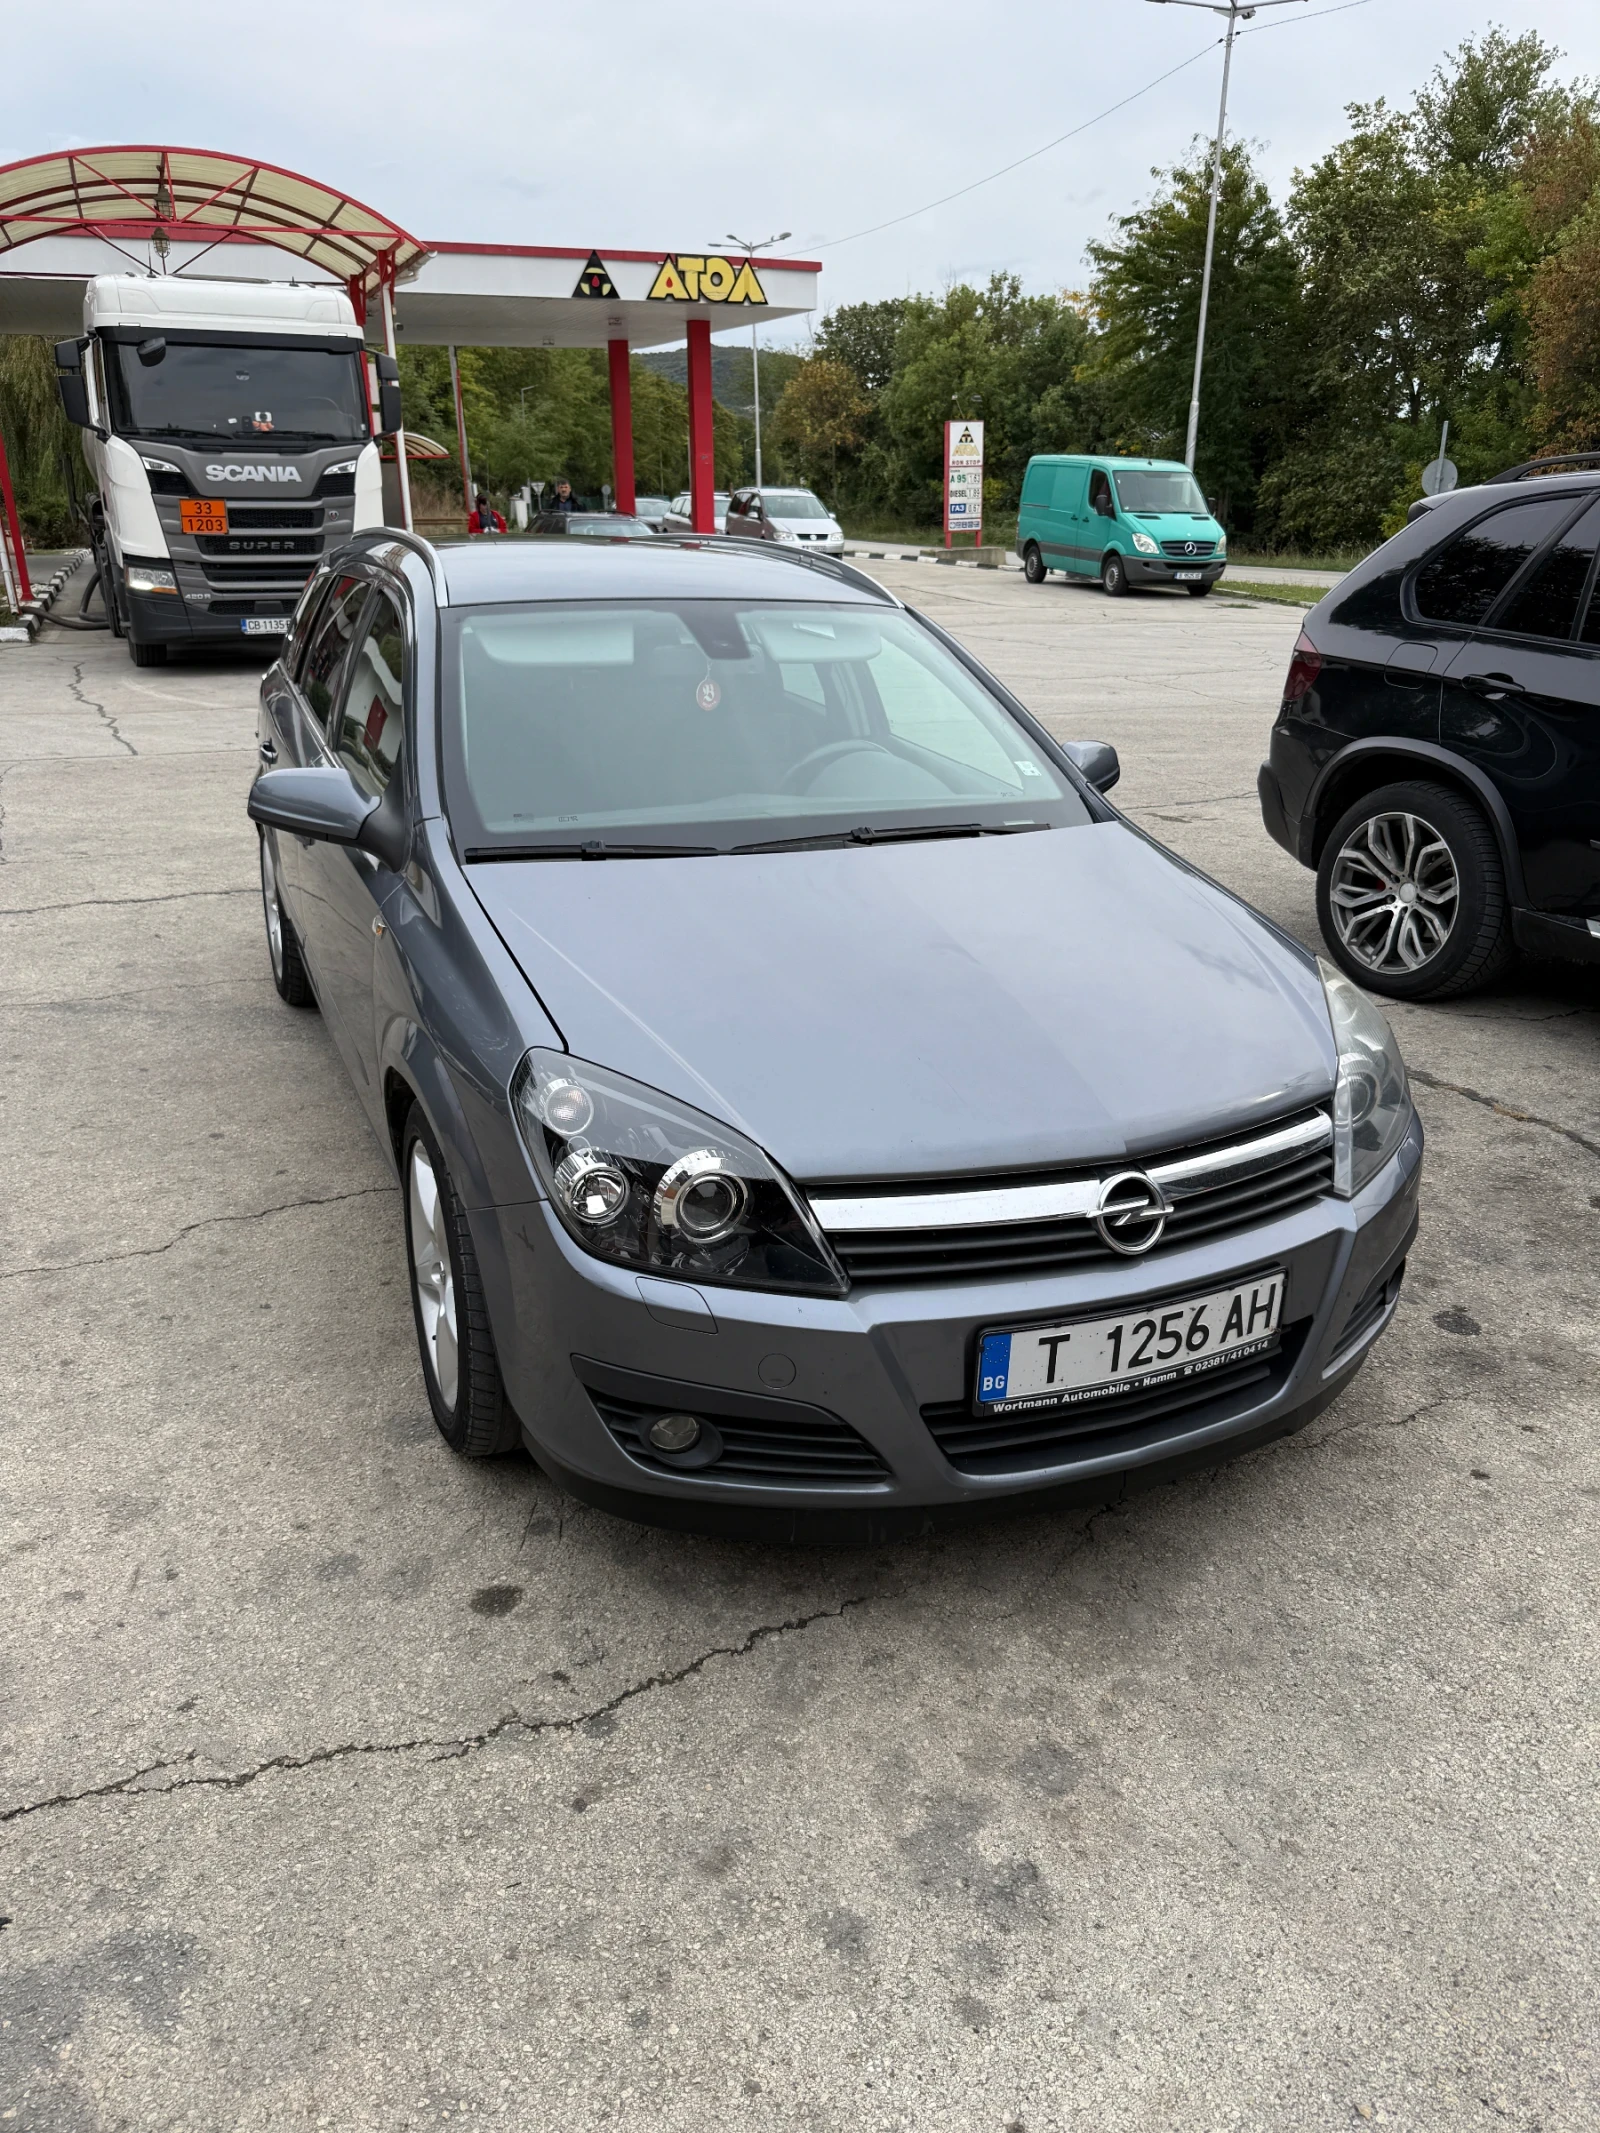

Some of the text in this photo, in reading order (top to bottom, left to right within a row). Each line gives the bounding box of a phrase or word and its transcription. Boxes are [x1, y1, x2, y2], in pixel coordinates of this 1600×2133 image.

[646, 253, 768, 305] АТОЛ
[205, 464, 303, 483] SCANIA
[957, 474, 966, 483] 95
[194, 502, 212, 515] 33
[951, 504, 965, 512] ГАЗ
[187, 518, 224, 532] 1203
[228, 541, 295, 550] SUPER
[263, 620, 286, 630] 1135
[1038, 1282, 1277, 1384] T 1256 AH
[982, 1375, 1005, 1391] BG
[993, 1397, 1058, 1413] Wortmann
[1062, 1382, 1131, 1403] Automobile
[1143, 1371, 1177, 1387] Hamm
